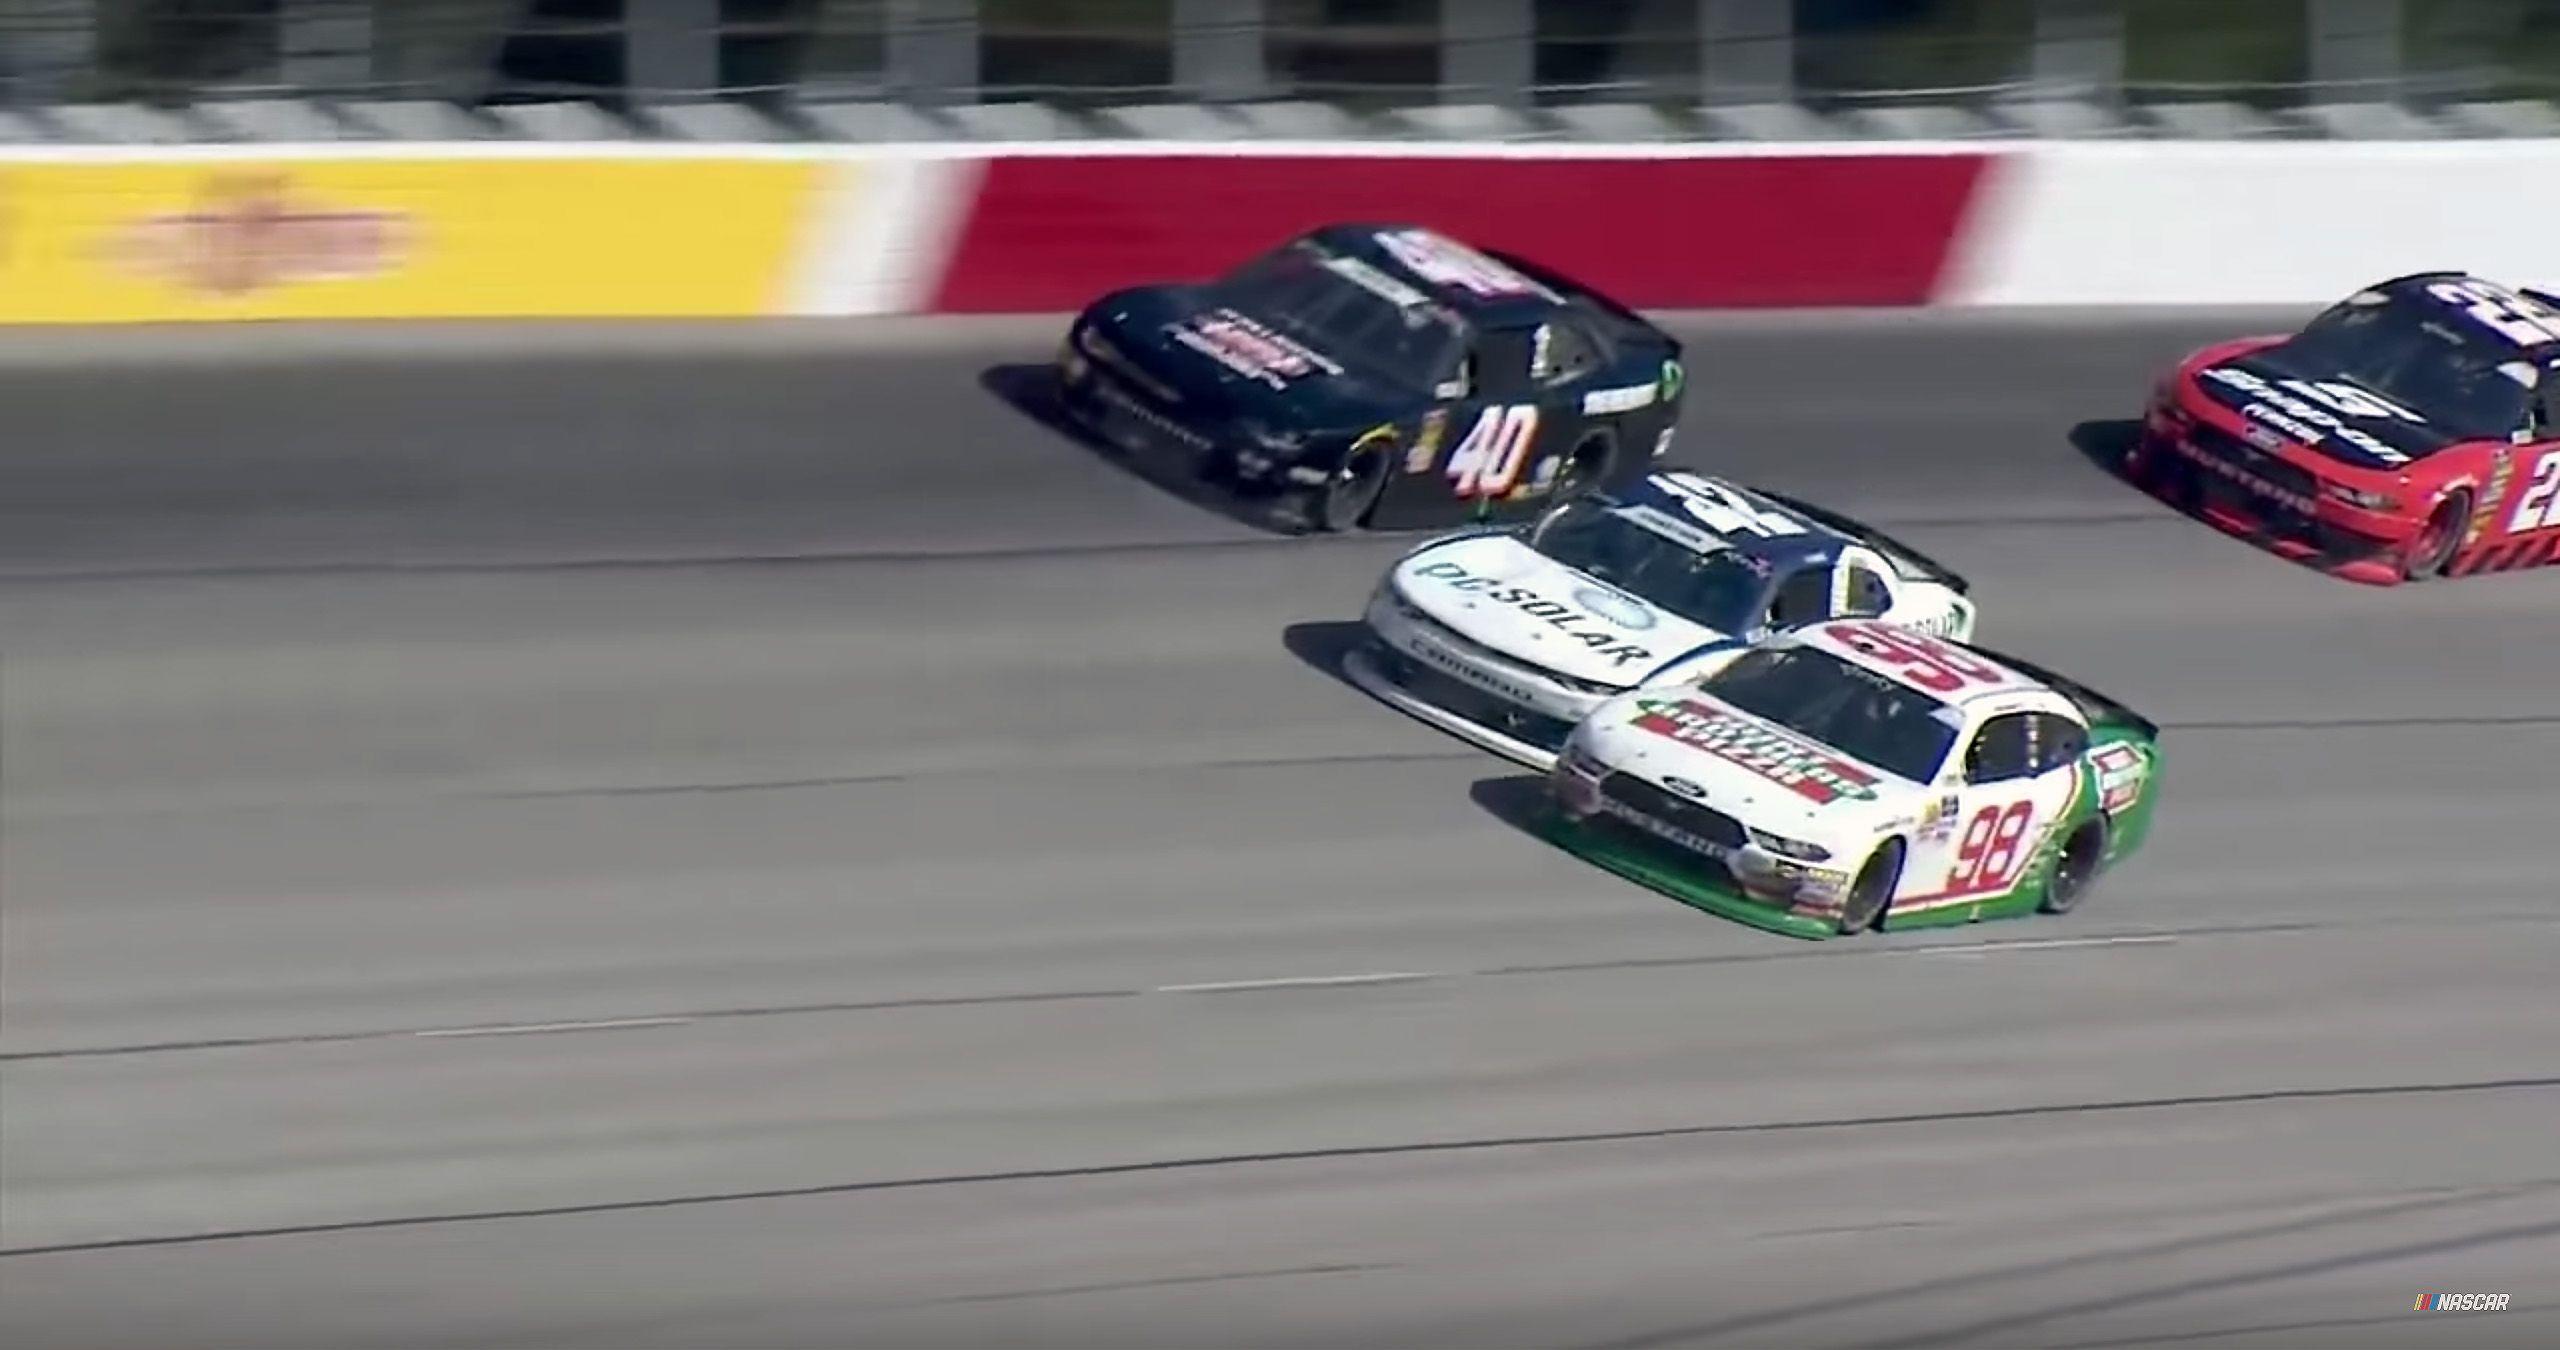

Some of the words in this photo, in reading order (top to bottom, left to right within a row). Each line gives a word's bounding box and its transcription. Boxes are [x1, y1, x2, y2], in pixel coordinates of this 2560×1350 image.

[1446, 404, 1540, 497] 40
[1488, 588, 1653, 667] SOLAR
[1946, 799, 2034, 894] 98
